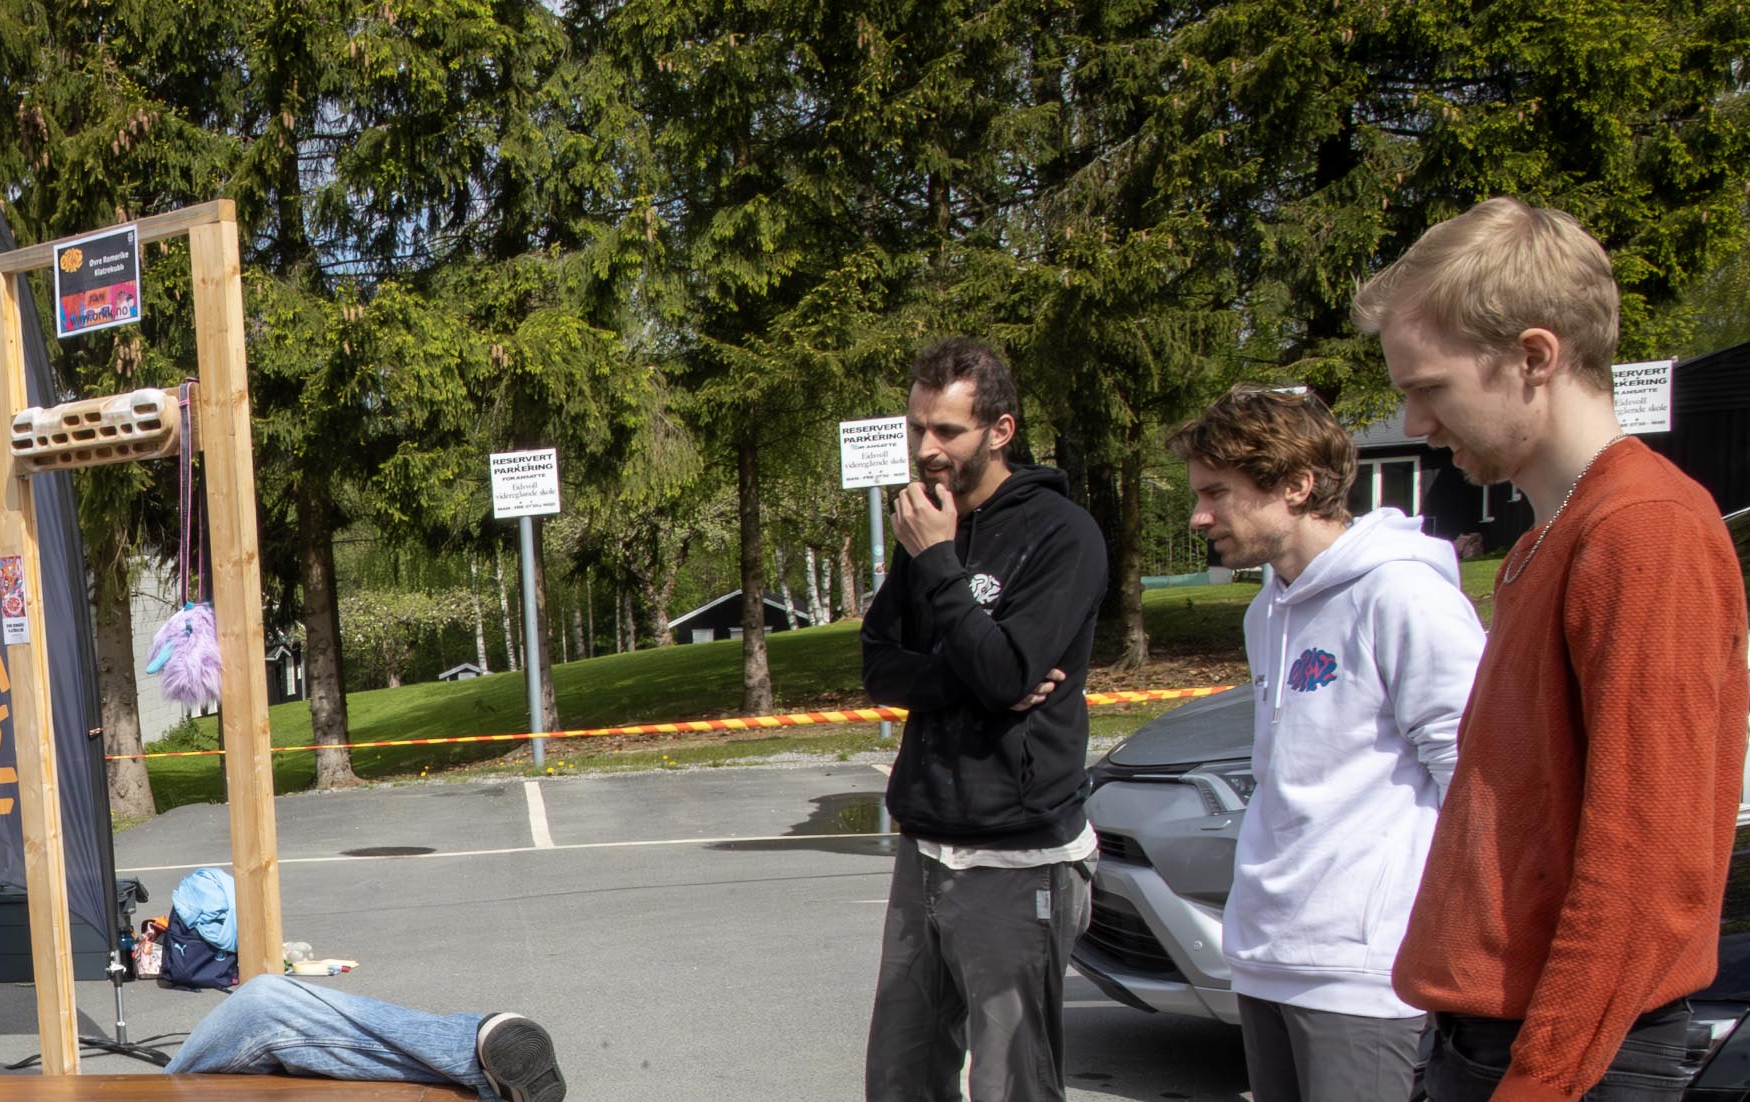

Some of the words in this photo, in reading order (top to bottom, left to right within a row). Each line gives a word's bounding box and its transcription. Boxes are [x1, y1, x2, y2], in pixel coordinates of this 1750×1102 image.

[1612, 367, 1668, 378] SERVERT
[842, 423, 904, 434] RESERVERT
[844, 432, 904, 444] PARKERING
[492, 454, 553, 465] RESERVERT
[494, 463, 553, 475] PARKERING
